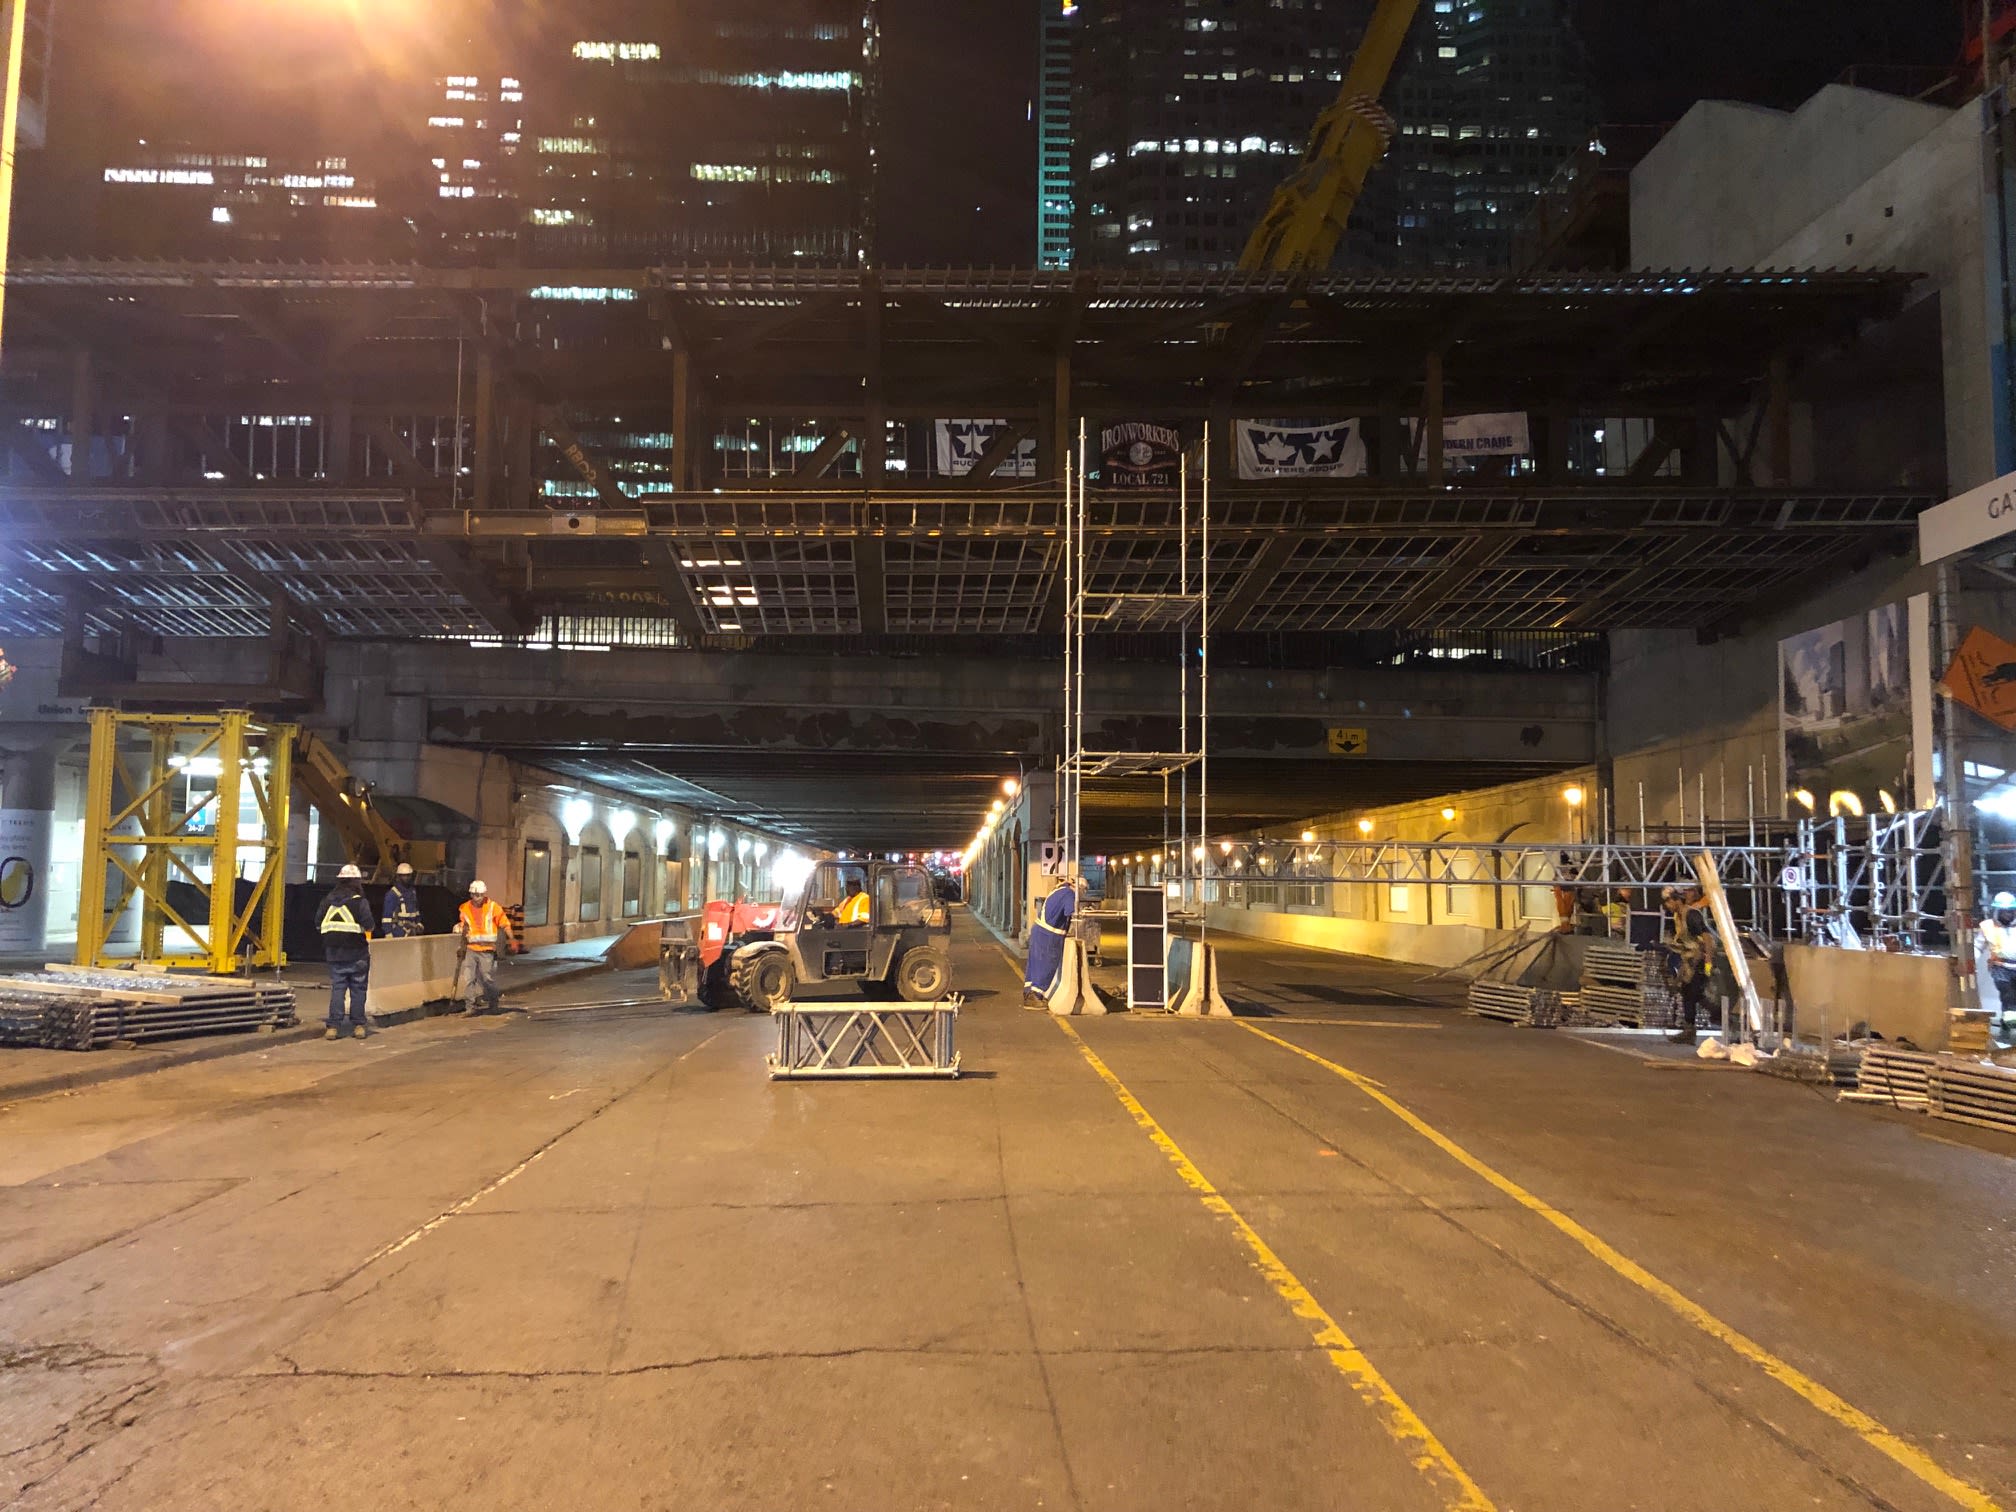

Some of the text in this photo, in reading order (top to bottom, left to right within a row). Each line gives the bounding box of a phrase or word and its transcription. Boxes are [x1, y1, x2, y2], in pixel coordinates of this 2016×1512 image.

[1101, 422, 1179, 453] IRONWORKERS
[1442, 439, 1474, 450] DERN
[1113, 473, 1169, 485] LOCAL 721
[1988, 489, 2016, 519] GA
